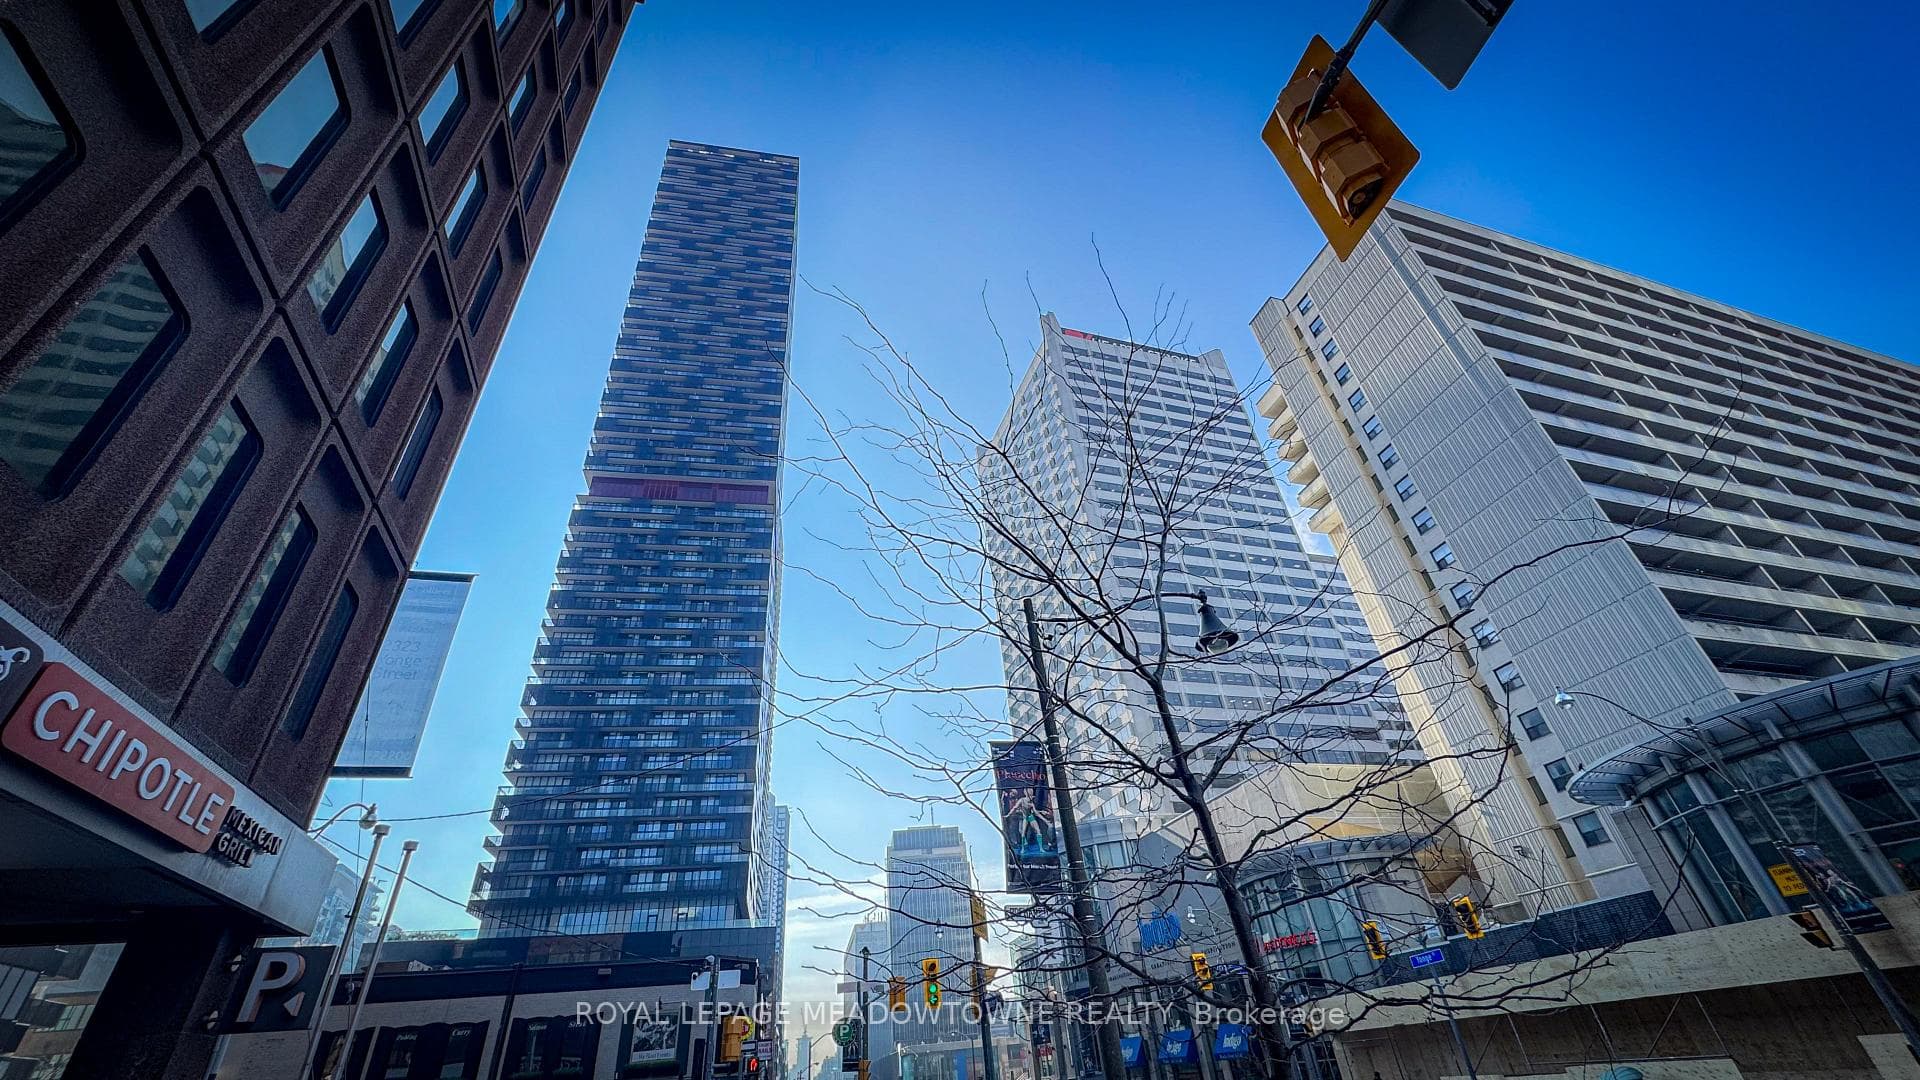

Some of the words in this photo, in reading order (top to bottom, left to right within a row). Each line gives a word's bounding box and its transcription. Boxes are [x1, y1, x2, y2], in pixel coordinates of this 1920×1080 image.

[33, 690, 227, 837] CHIPOTLE
[217, 832, 256, 868] GRILL
[225, 806, 283, 855] MEXICAN
[236, 952, 307, 1022] P
